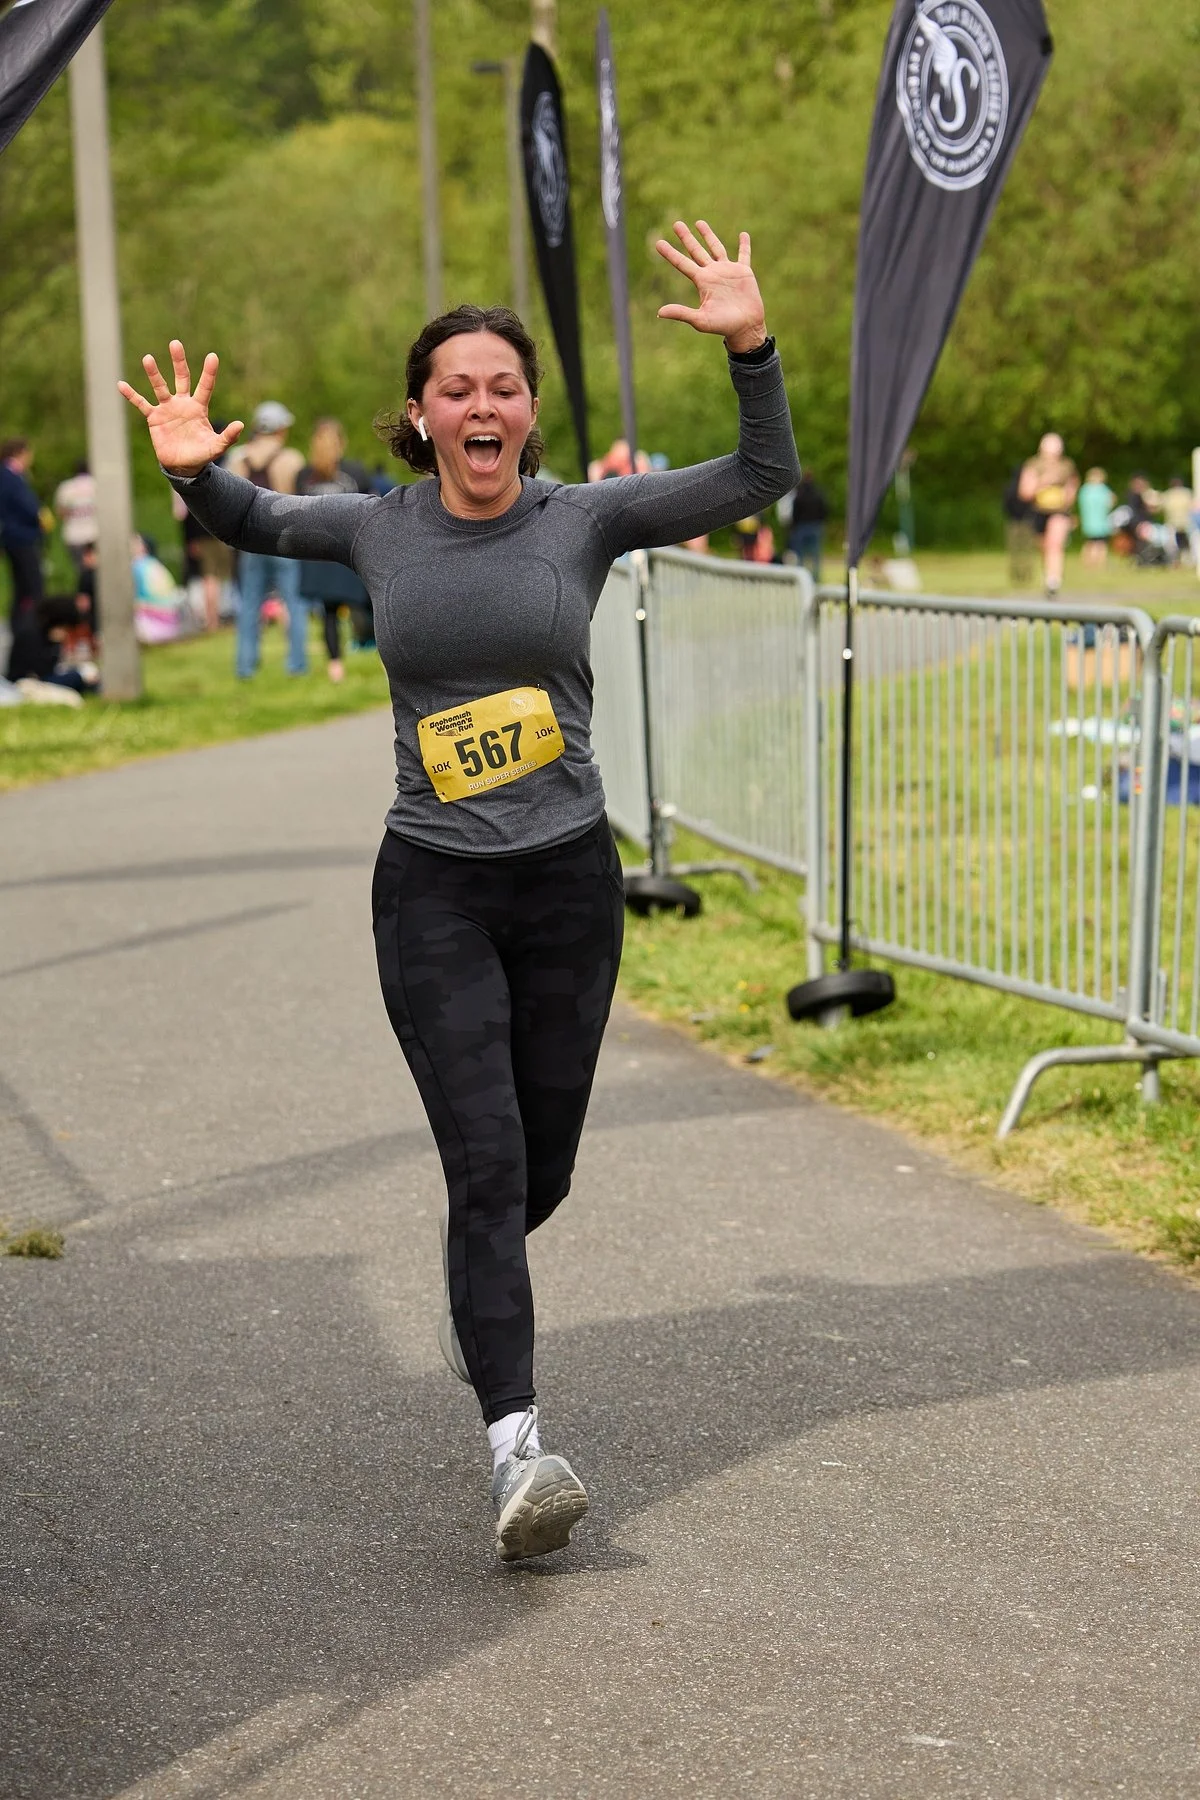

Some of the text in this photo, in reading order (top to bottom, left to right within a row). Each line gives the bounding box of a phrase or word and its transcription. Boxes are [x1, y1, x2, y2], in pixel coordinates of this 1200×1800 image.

[429, 710, 472, 729] Snohomish
[458, 723, 474, 732] Run
[535, 726, 555, 739] 10K
[454, 721, 522, 777] 567
[431, 761, 452, 774] 10K
[468, 760, 537, 791] RUN SUPER SERIES
